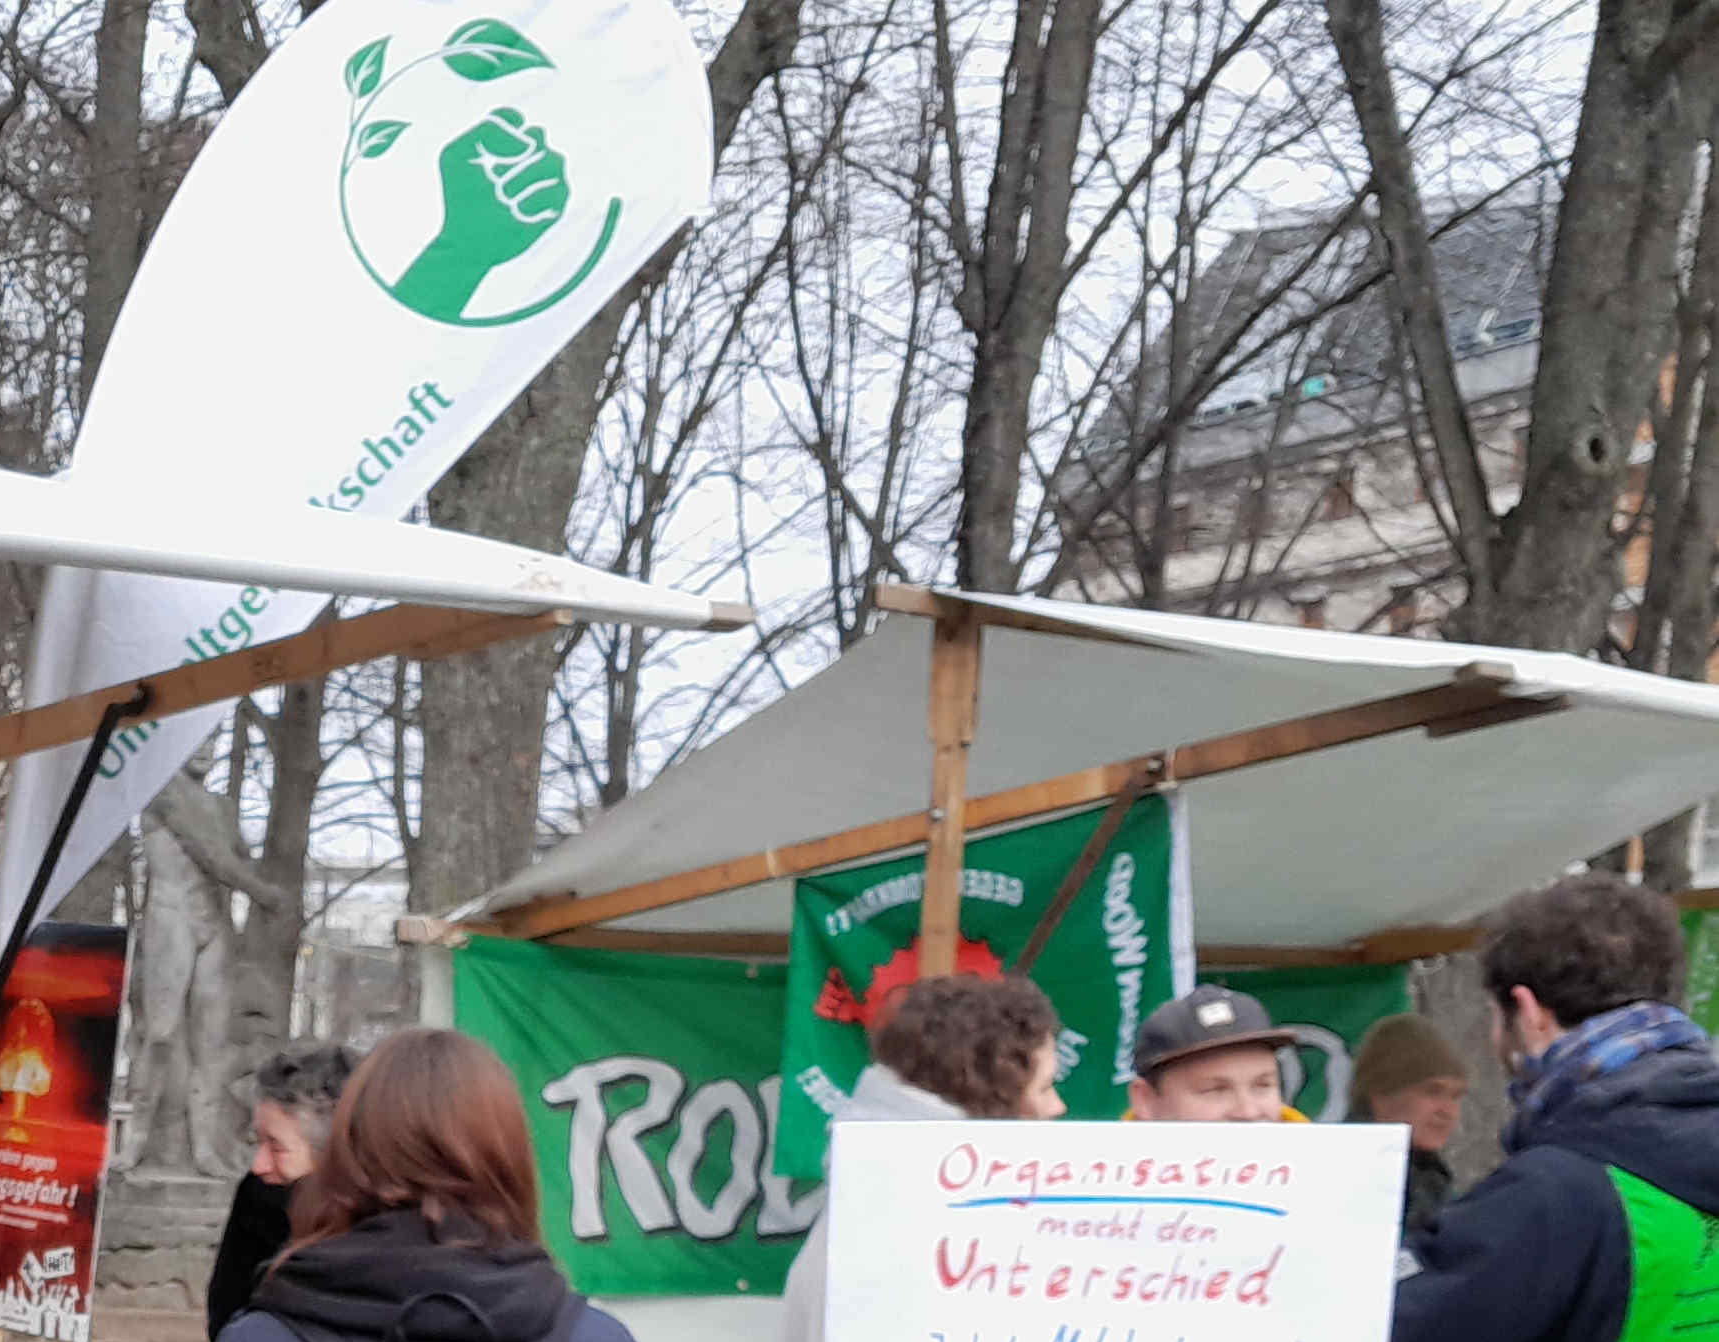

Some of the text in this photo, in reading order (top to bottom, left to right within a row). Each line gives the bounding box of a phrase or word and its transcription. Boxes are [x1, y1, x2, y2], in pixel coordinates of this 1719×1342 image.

[936, 1142, 1292, 1208] Organisation
[1037, 1206, 1218, 1243] macht den
[936, 1237, 1285, 1307] Unterschied
